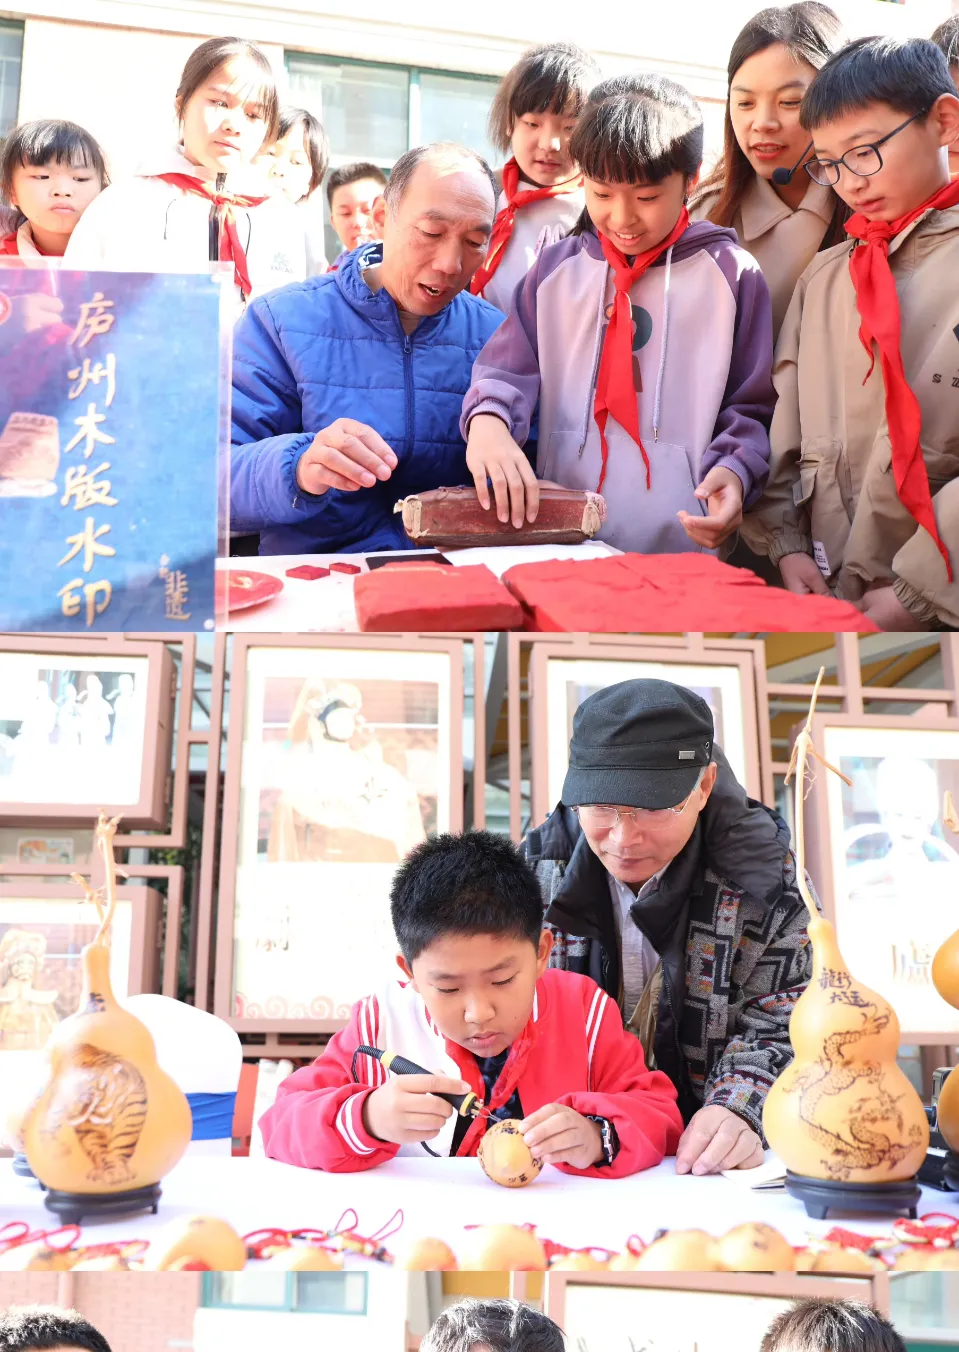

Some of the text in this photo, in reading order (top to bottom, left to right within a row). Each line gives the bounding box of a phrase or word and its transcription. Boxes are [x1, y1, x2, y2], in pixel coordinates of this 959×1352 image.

[57, 292, 119, 627] 庐州木版水印
